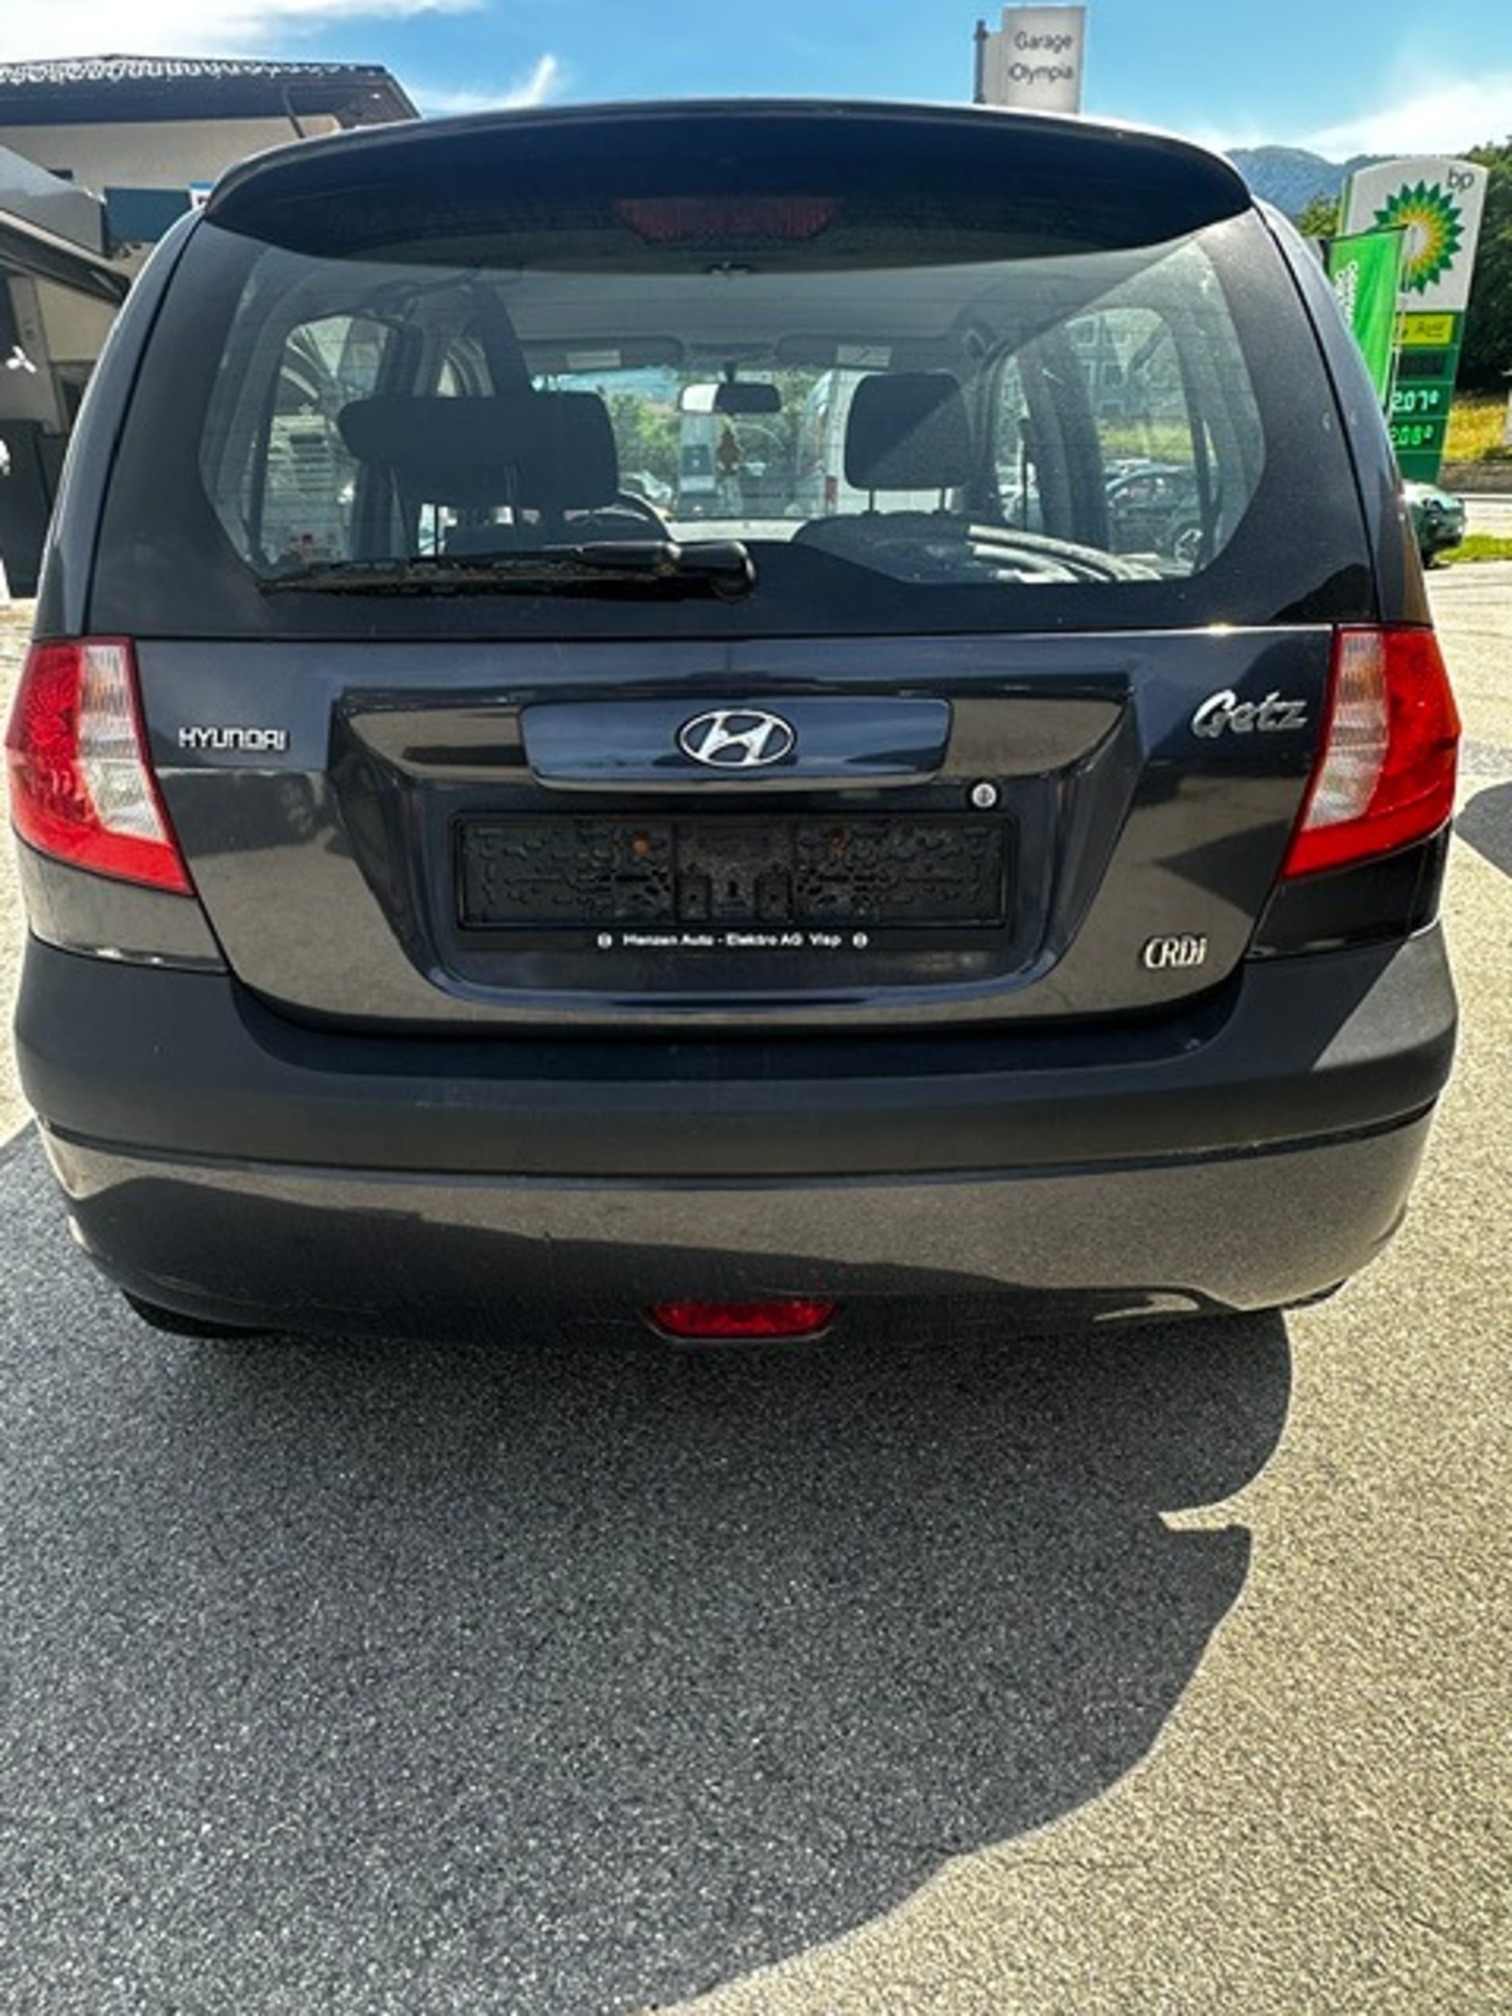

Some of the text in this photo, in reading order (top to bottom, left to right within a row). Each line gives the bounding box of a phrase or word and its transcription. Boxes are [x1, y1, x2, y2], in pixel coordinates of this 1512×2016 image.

[1014, 31, 1072, 54] Garage
[1008, 62, 1074, 85] Olympia
[1446, 167, 1475, 194] bp
[1191, 689, 1308, 738] Getz
[178, 726, 288, 751] HYUNDAI
[680, 933, 714, 947] Auto
[780, 932, 803, 947] AG
[1144, 937, 1208, 969] CRDi
